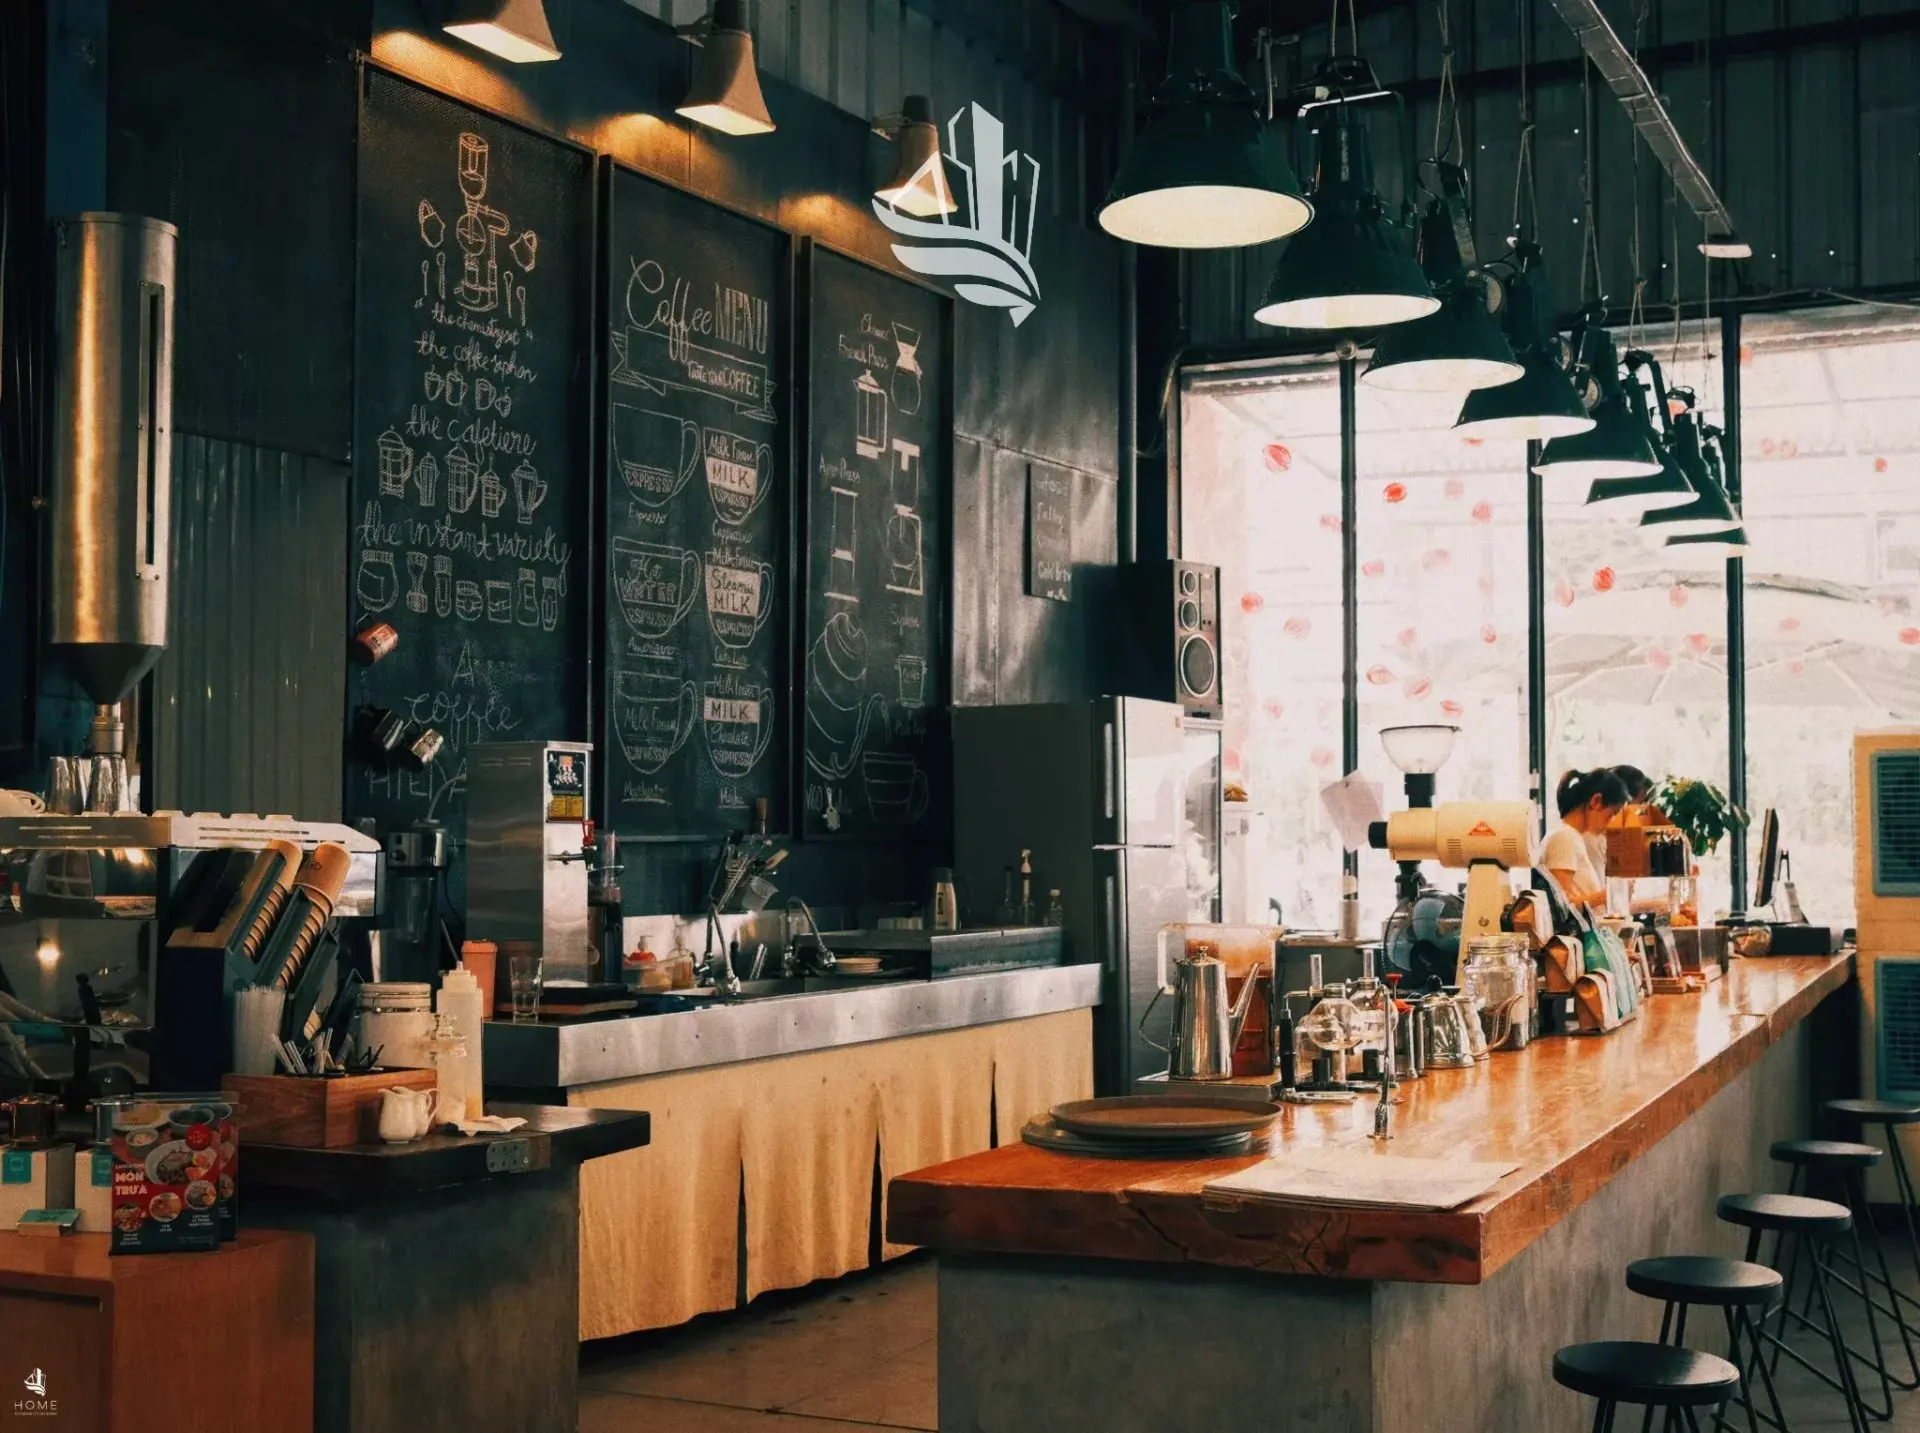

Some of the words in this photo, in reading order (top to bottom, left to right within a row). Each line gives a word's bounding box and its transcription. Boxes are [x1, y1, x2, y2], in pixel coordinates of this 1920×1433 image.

[626, 255, 713, 364] Coffee
[714, 281, 769, 355] MENU
[414, 331, 449, 360] the
[405, 404, 443, 440] the
[711, 463, 751, 489] MILK
[356, 500, 400, 547] the
[714, 590, 751, 614] MILK
[451, 639, 474, 687] A
[711, 701, 749, 720] MILK
